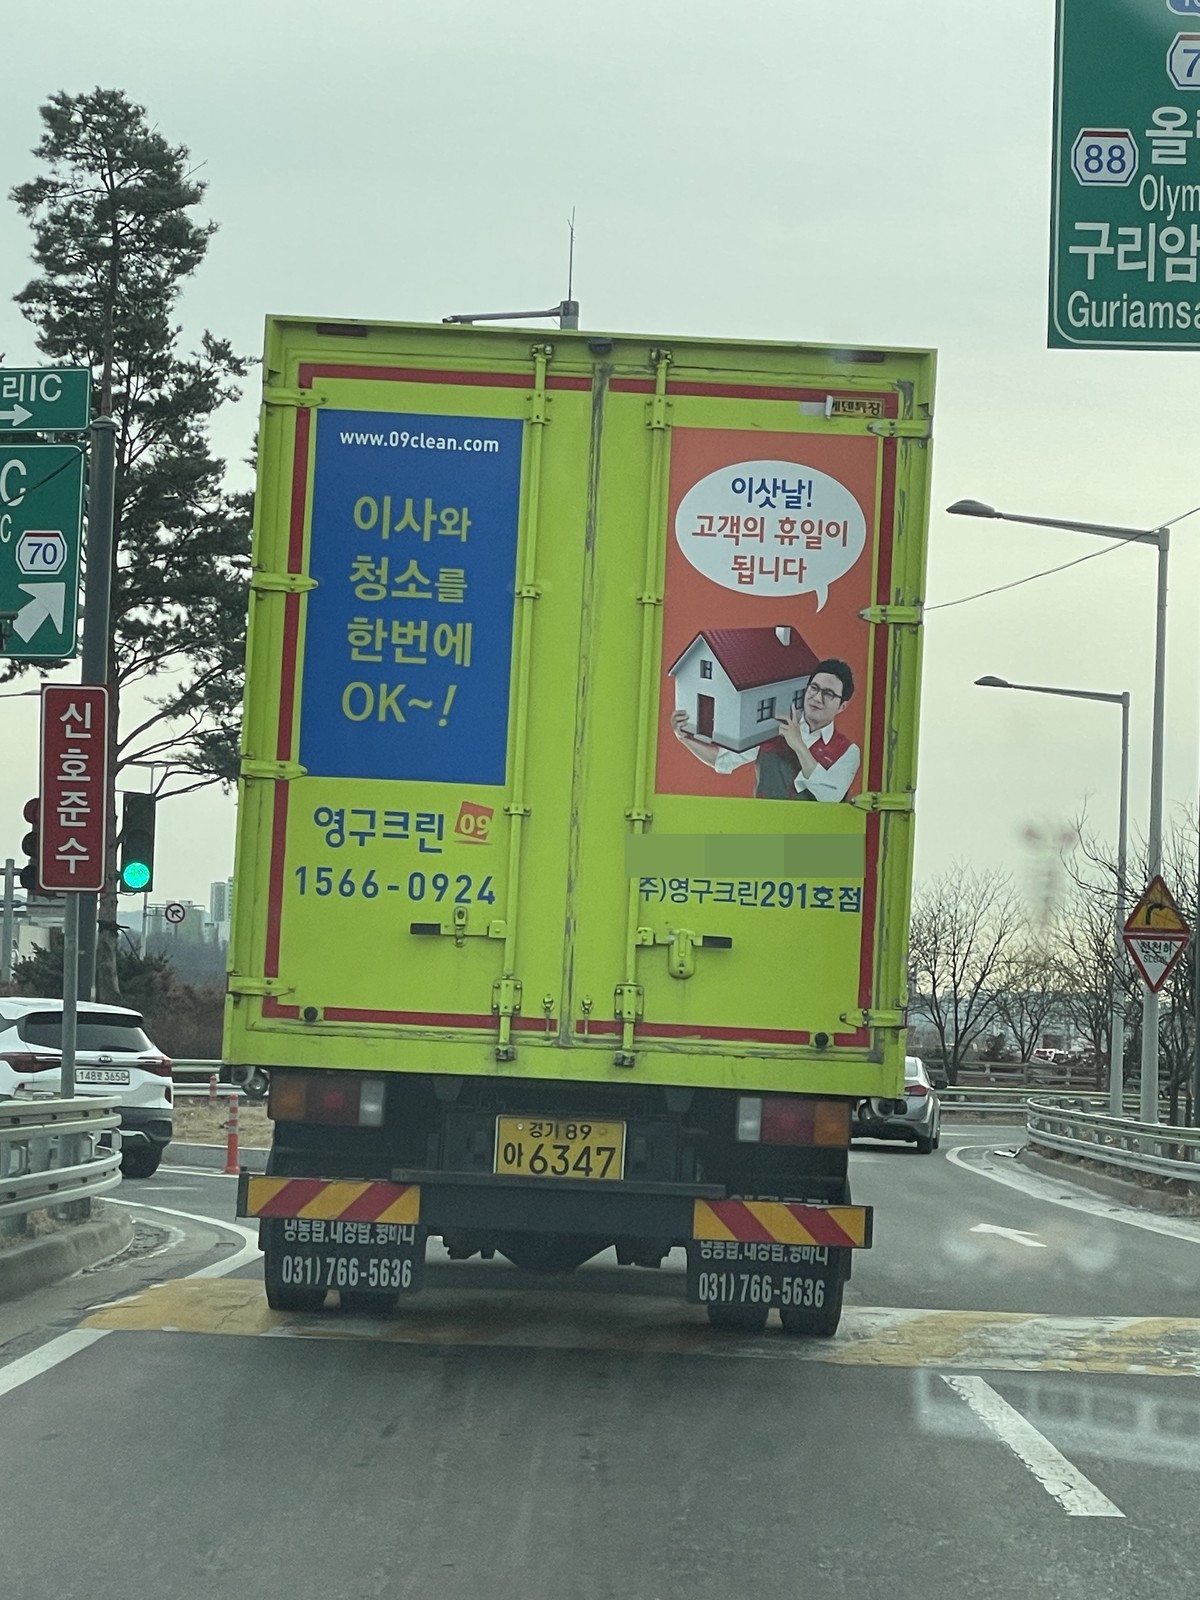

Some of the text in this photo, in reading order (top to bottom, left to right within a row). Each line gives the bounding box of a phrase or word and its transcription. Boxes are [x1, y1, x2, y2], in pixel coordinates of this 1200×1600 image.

[1145, 106, 1200, 166] 올
[1083, 144, 1127, 174] 88
[339, 430, 500, 453] www.09clean.com
[731, 476, 813, 510] 이삿날!
[353, 495, 473, 543] 이사와
[691, 514, 849, 550] 고객의 휴일이
[27, 542, 58, 565] 70
[730, 554, 808, 586] 됩니다
[349, 554, 469, 604] 청소를
[346, 616, 473, 668] 한번에
[55, 702, 92, 875] 신호준수
[313, 806, 445, 854] 영구크린
[295, 865, 496, 905] 1566-0924
[529, 1121, 592, 1141] 경기 89
